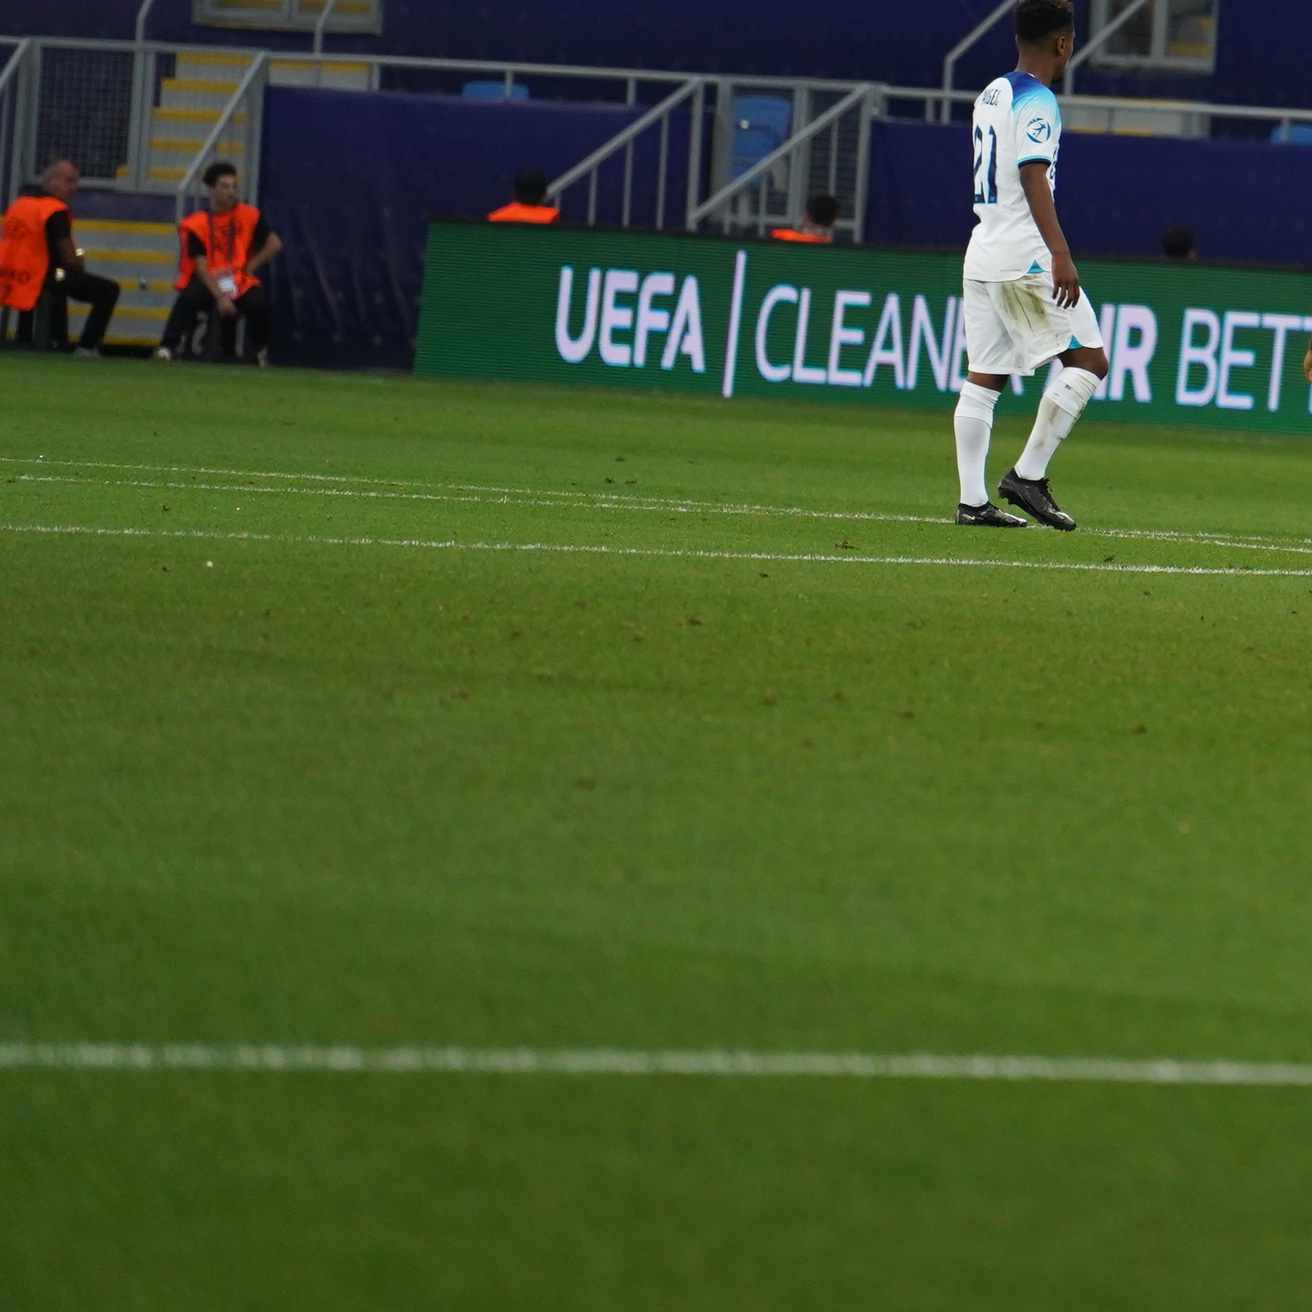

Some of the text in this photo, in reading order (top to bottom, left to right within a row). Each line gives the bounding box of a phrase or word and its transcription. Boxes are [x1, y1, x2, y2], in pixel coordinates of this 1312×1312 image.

[555, 265, 706, 374] UEFA
[755, 283, 1025, 396] CLEAN
[1042, 302, 1158, 404] IR
